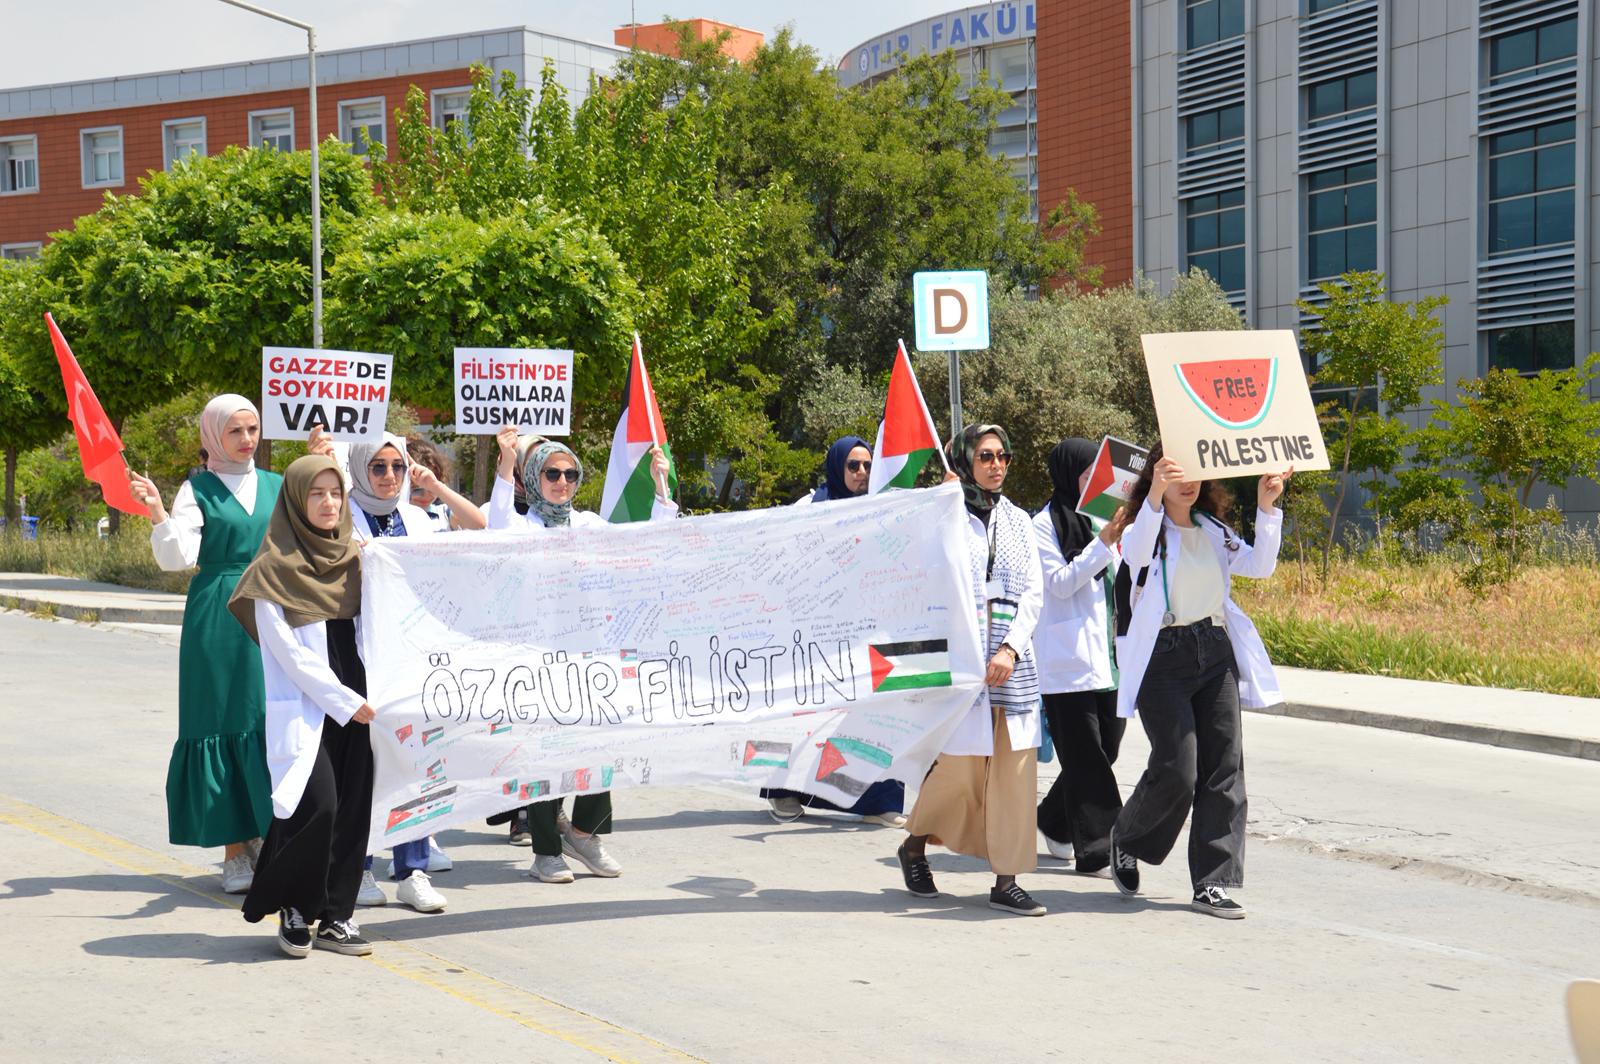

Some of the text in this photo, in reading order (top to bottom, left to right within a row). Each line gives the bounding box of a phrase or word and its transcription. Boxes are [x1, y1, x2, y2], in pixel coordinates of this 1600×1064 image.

[933, 288, 968, 334] D
[269, 356, 387, 380] GAZZE'DE
[461, 357, 568, 381] FİLİSTİN'DE
[268, 379, 386, 402] SOYKIRIM
[461, 384, 566, 403] OLANLARA
[1213, 376, 1257, 399] FREE
[279, 402, 370, 434] VAR!
[462, 406, 564, 426] SUSMAYIN
[1196, 435, 1315, 468] PALESTINE
[422, 629, 856, 725] ÖZGÜR FİLİSTİN
